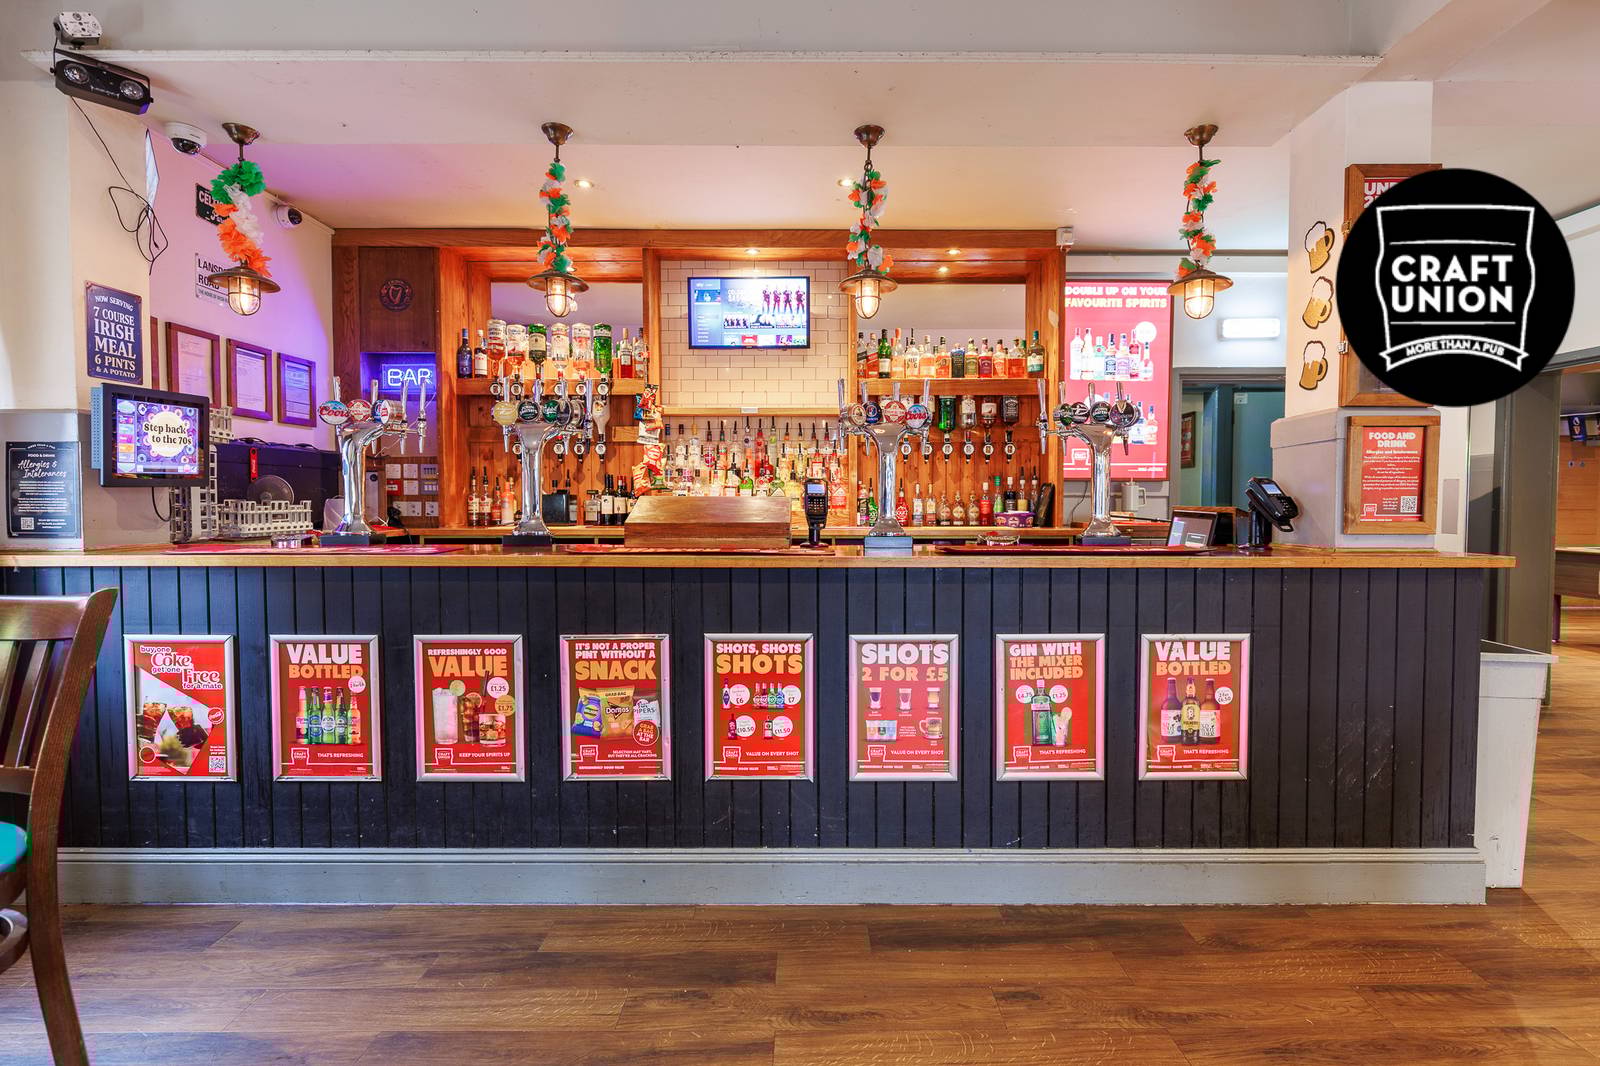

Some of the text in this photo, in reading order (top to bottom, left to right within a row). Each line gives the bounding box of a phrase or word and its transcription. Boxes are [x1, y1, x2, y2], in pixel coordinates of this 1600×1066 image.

[1065, 286, 1167, 296] DOUBLE UP ON YOUR
[110, 296, 134, 311] SERVING
[1065, 299, 1167, 308] FAVOURITE SPIRITS
[94, 306, 134, 326] 7 COURSE
[94, 318, 135, 342] IRISH
[95, 336, 136, 359] MEAL
[94, 354, 135, 371] 6 PINTS
[110, 369, 135, 378] POTATO
[388, 368, 432, 386] BAR
[319, 406, 350, 417] Coors
[904, 411, 928, 421] Coors
[144, 423, 186, 435] Step back
[163, 435, 176, 443] the
[18, 460, 50, 471] Allergies
[22, 469, 67, 478] Intolerances
[286, 644, 362, 664] VALUE
[576, 650, 656, 659] PINT WITHOUT A
[716, 644, 801, 655] SHOTS, SHOTS
[862, 644, 949, 664] SHOTS
[1010, 642, 1082, 656] GIN WITH
[1155, 642, 1230, 660] VALUE
[152, 653, 190, 667] Coke
[428, 656, 507, 677] VALUE
[716, 655, 803, 674] SHOTS
[1010, 655, 1083, 668] THE MIXER
[181, 669, 219, 682] Free
[289, 665, 363, 679] BOTTLED
[575, 660, 656, 680] SNACK
[862, 667, 948, 681] 2 FOR £5
[1010, 667, 1083, 680] INCLUDED
[1157, 661, 1231, 676] BOTTLED
